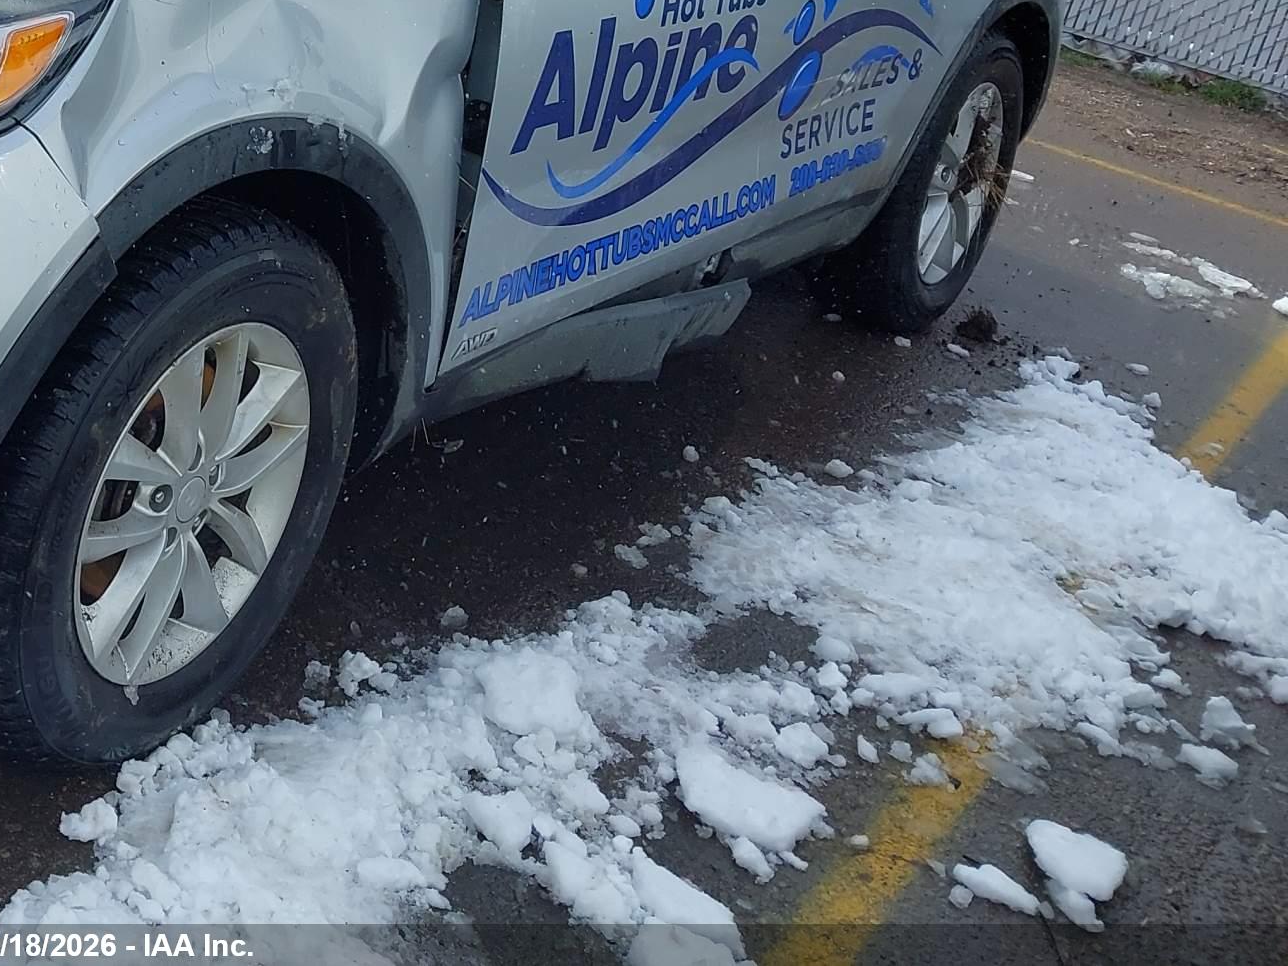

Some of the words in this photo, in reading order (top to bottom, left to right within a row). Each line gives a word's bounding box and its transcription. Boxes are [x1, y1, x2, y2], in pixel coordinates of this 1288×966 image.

[509, 15, 759, 155] Alpine
[908, 48, 924, 81] &
[780, 98, 876, 159] SERVICE
[459, 174, 776, 327] ALPINEHOTTUBSMCCALL.COM
[451, 328, 497, 361] AWD
